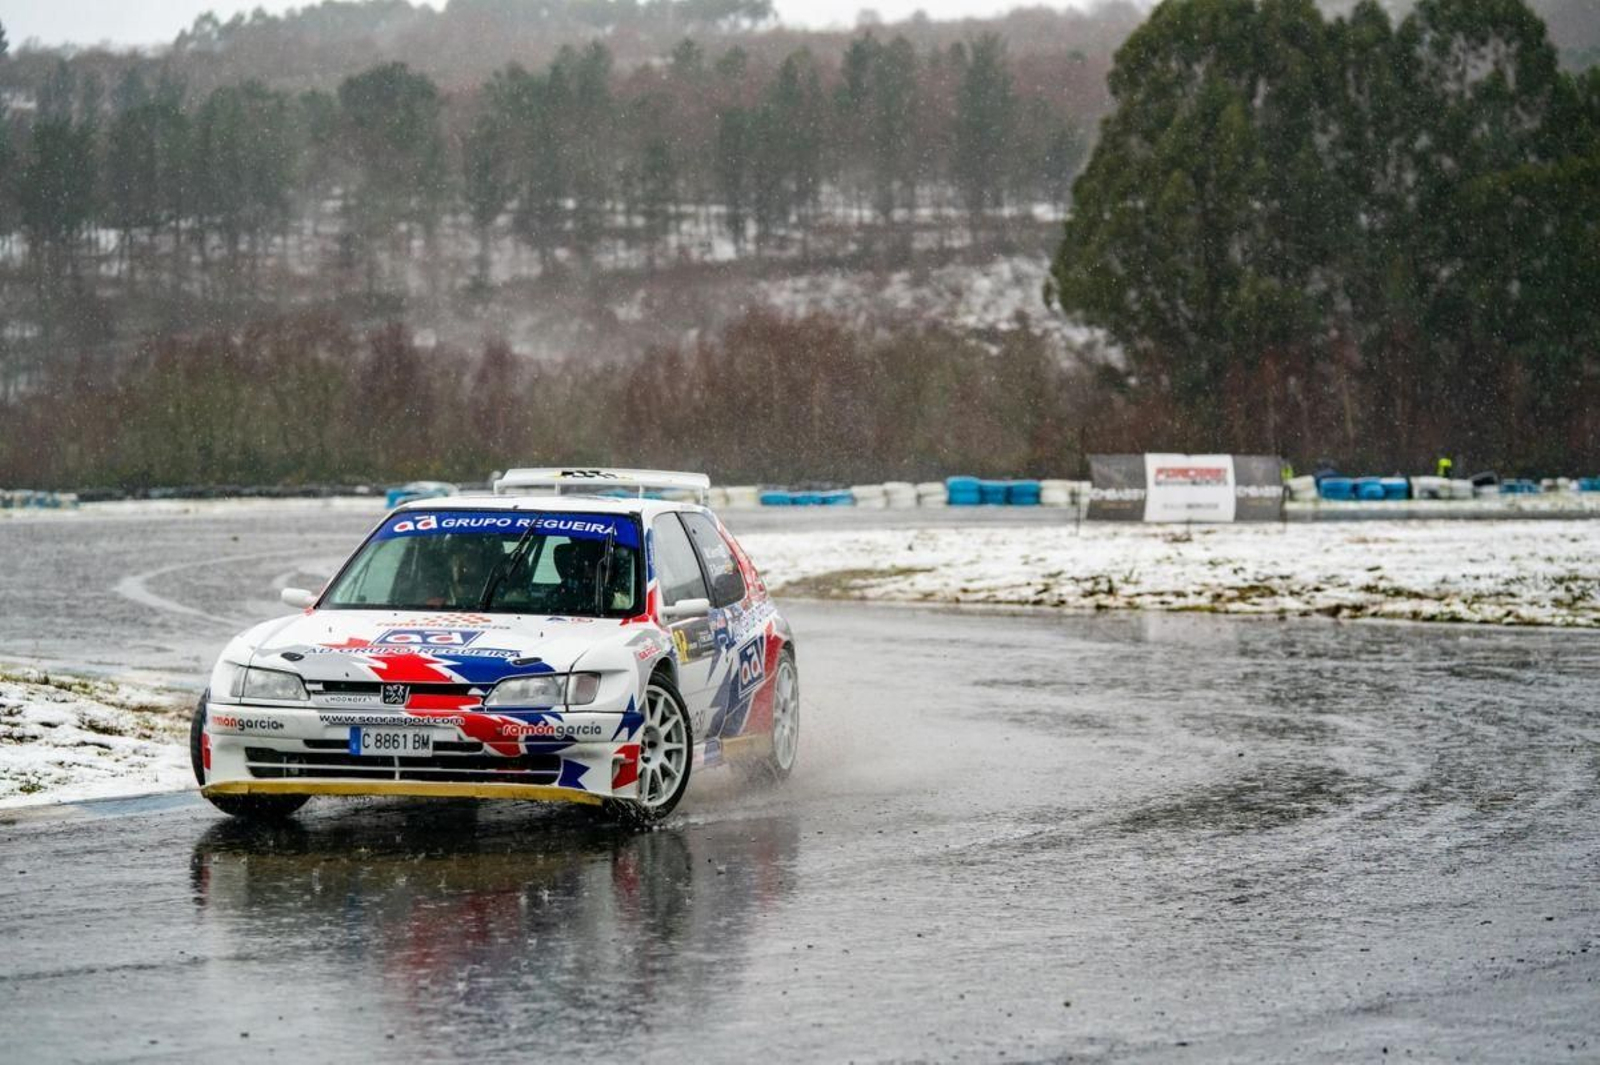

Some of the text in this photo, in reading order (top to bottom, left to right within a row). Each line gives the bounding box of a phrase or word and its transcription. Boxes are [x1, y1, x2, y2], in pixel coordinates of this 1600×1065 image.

[442, 517, 510, 528] GRUPO
[515, 519, 618, 535] REGUEIRA
[337, 647, 414, 655] GRUPO
[415, 648, 521, 658] REGUEIRA
[362, 733, 430, 750] C 8861 BM
